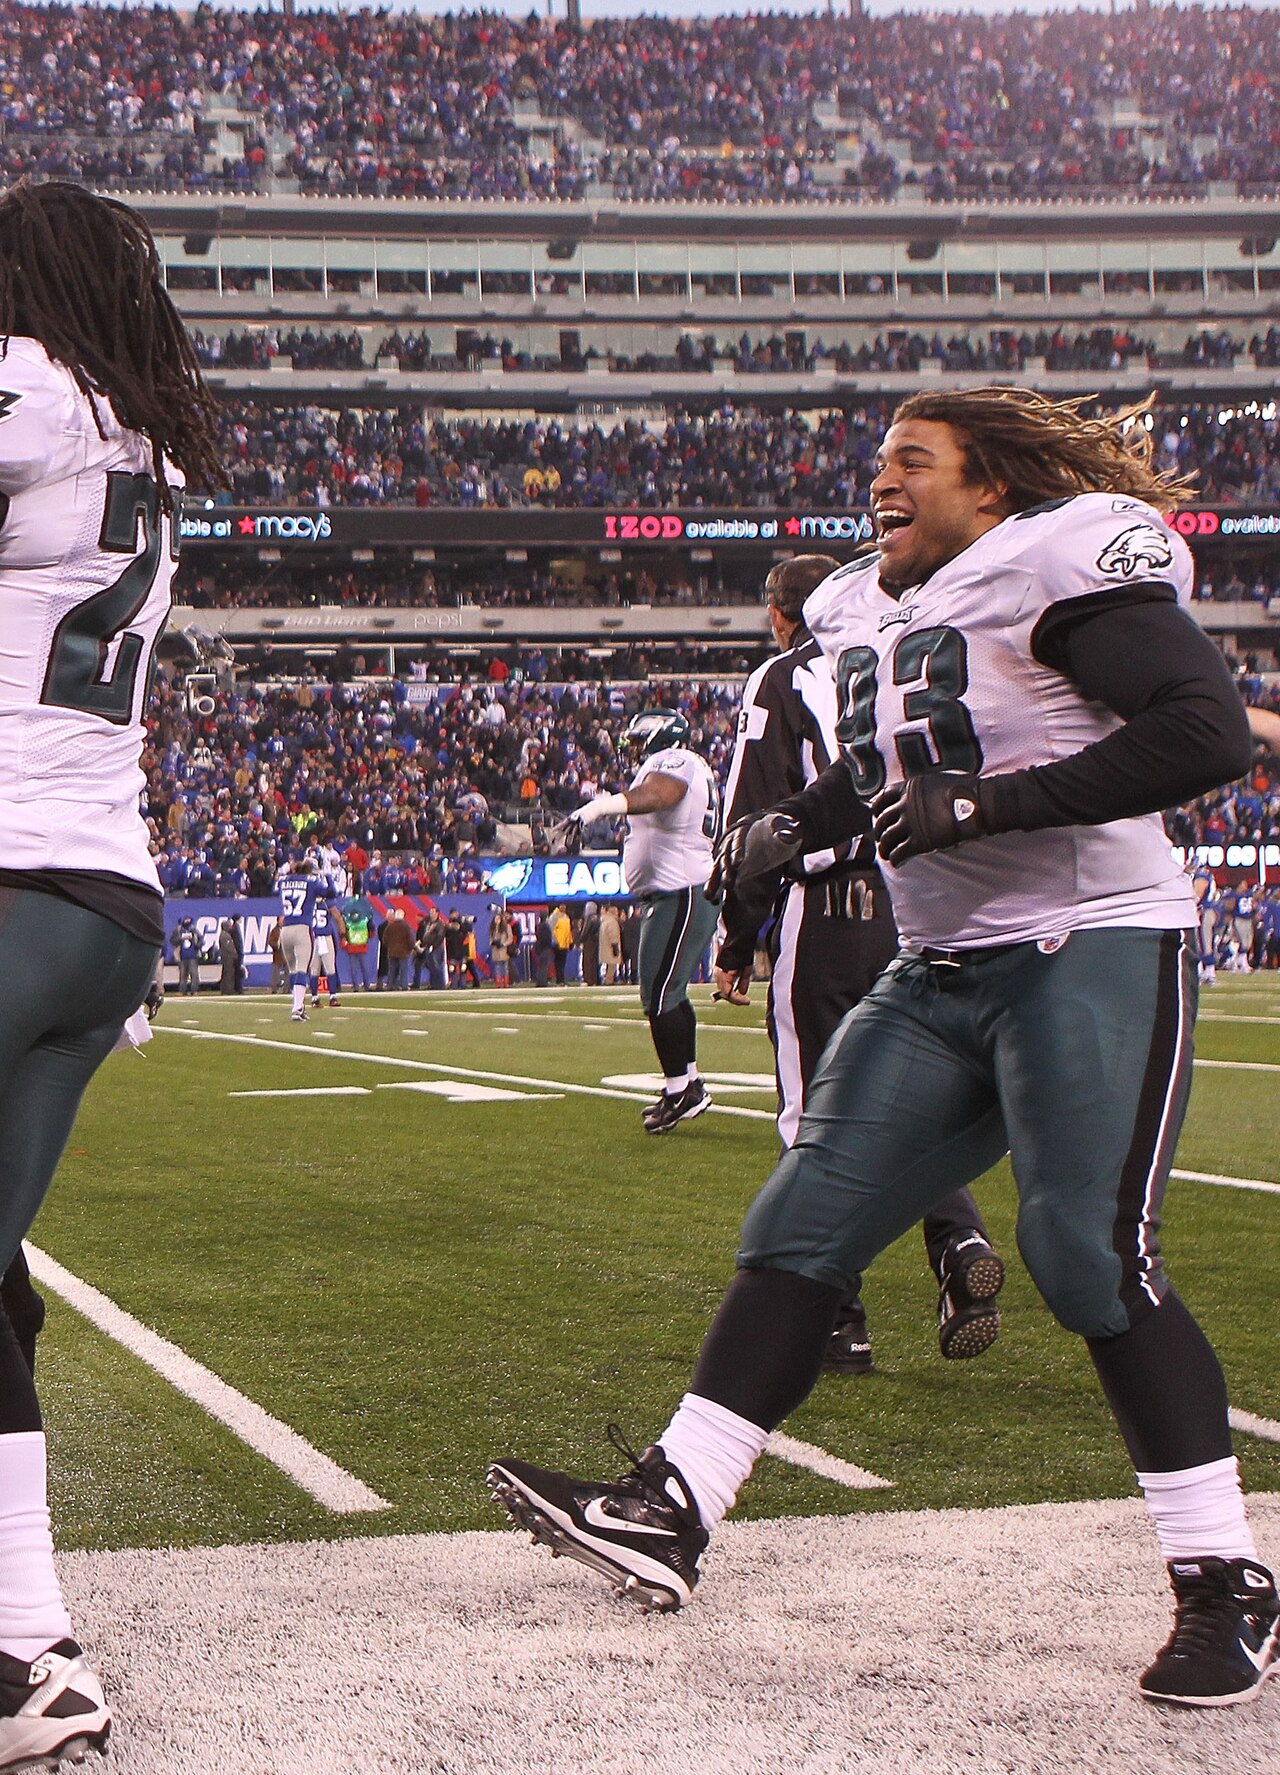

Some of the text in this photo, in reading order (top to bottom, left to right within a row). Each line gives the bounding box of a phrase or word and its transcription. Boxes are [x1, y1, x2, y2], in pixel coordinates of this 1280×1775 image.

[212, 519, 232, 536] at
[256, 512, 332, 542] macy's
[605, 513, 874, 542] IZOD available at macy's
[39, 469, 185, 726] 2
[284, 615, 370, 627] BUD LIGHT
[414, 612, 463, 629] pepsi
[835, 625, 984, 798] 93
[282, 889, 306, 915] 57
